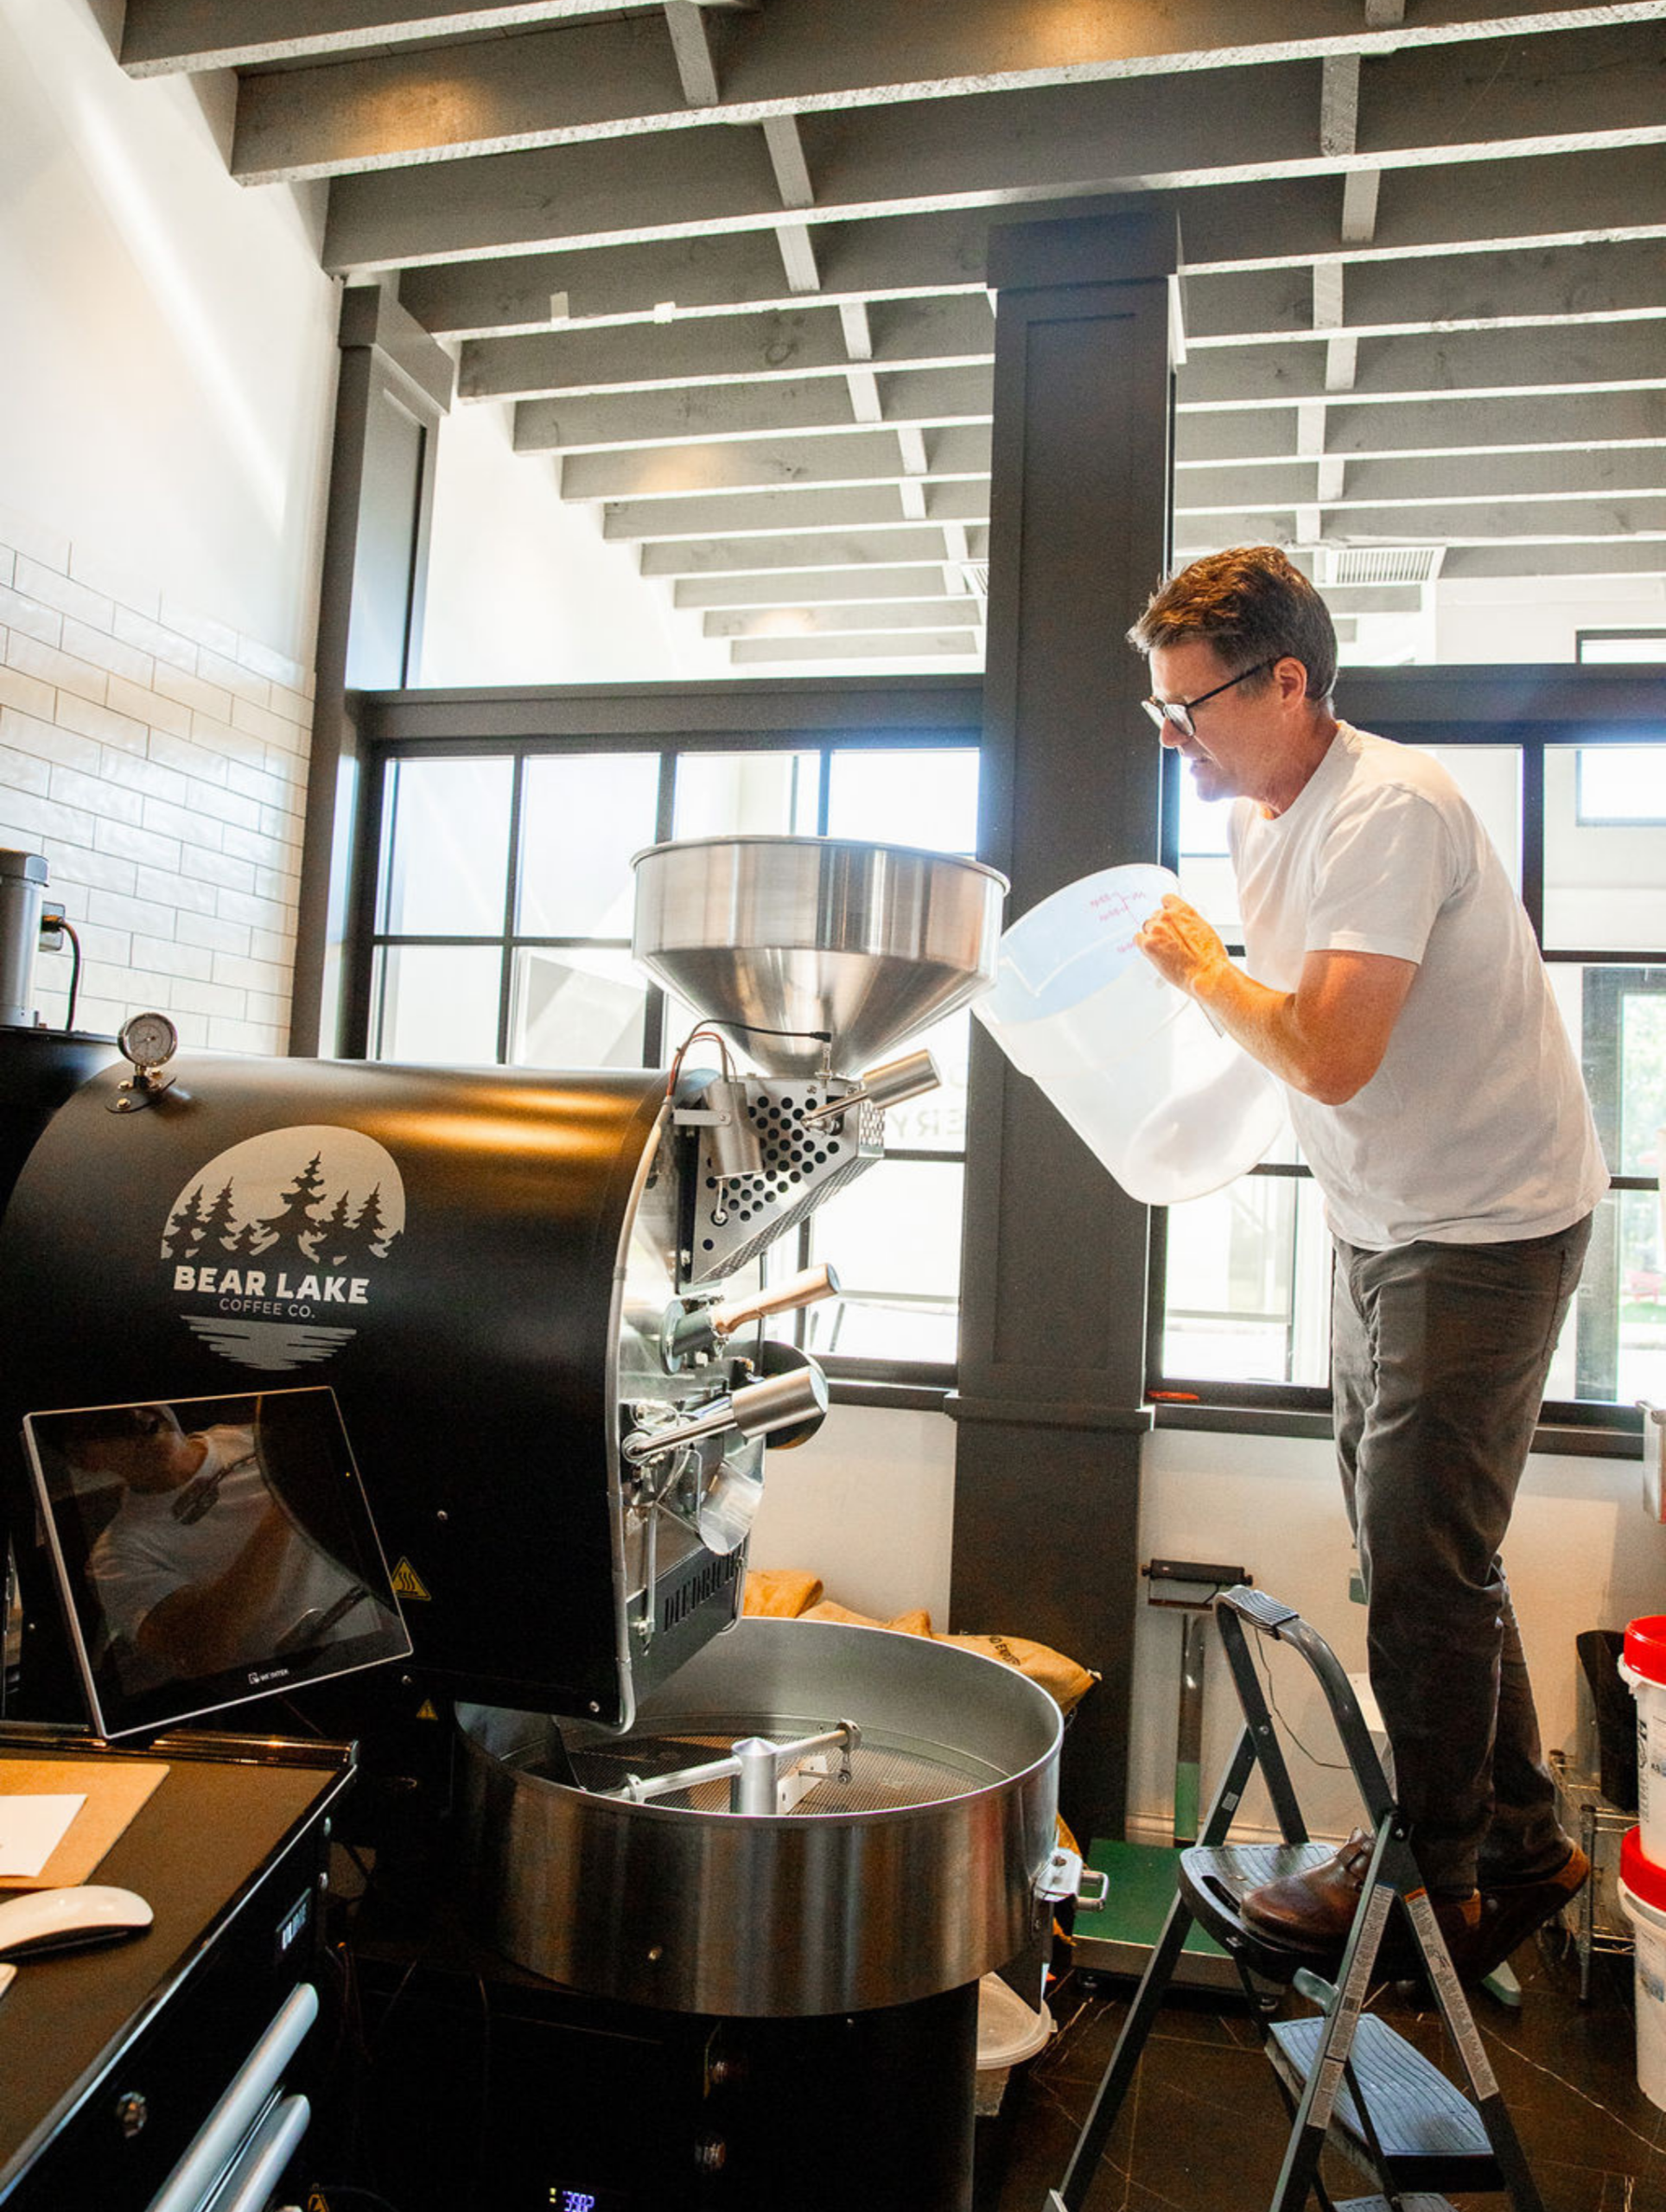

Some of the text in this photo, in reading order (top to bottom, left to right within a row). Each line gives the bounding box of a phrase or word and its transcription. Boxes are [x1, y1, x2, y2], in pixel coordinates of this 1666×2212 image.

[174, 1265, 370, 1305] BEAR LAKE
[219, 1298, 315, 1319] COFFEE CO.
